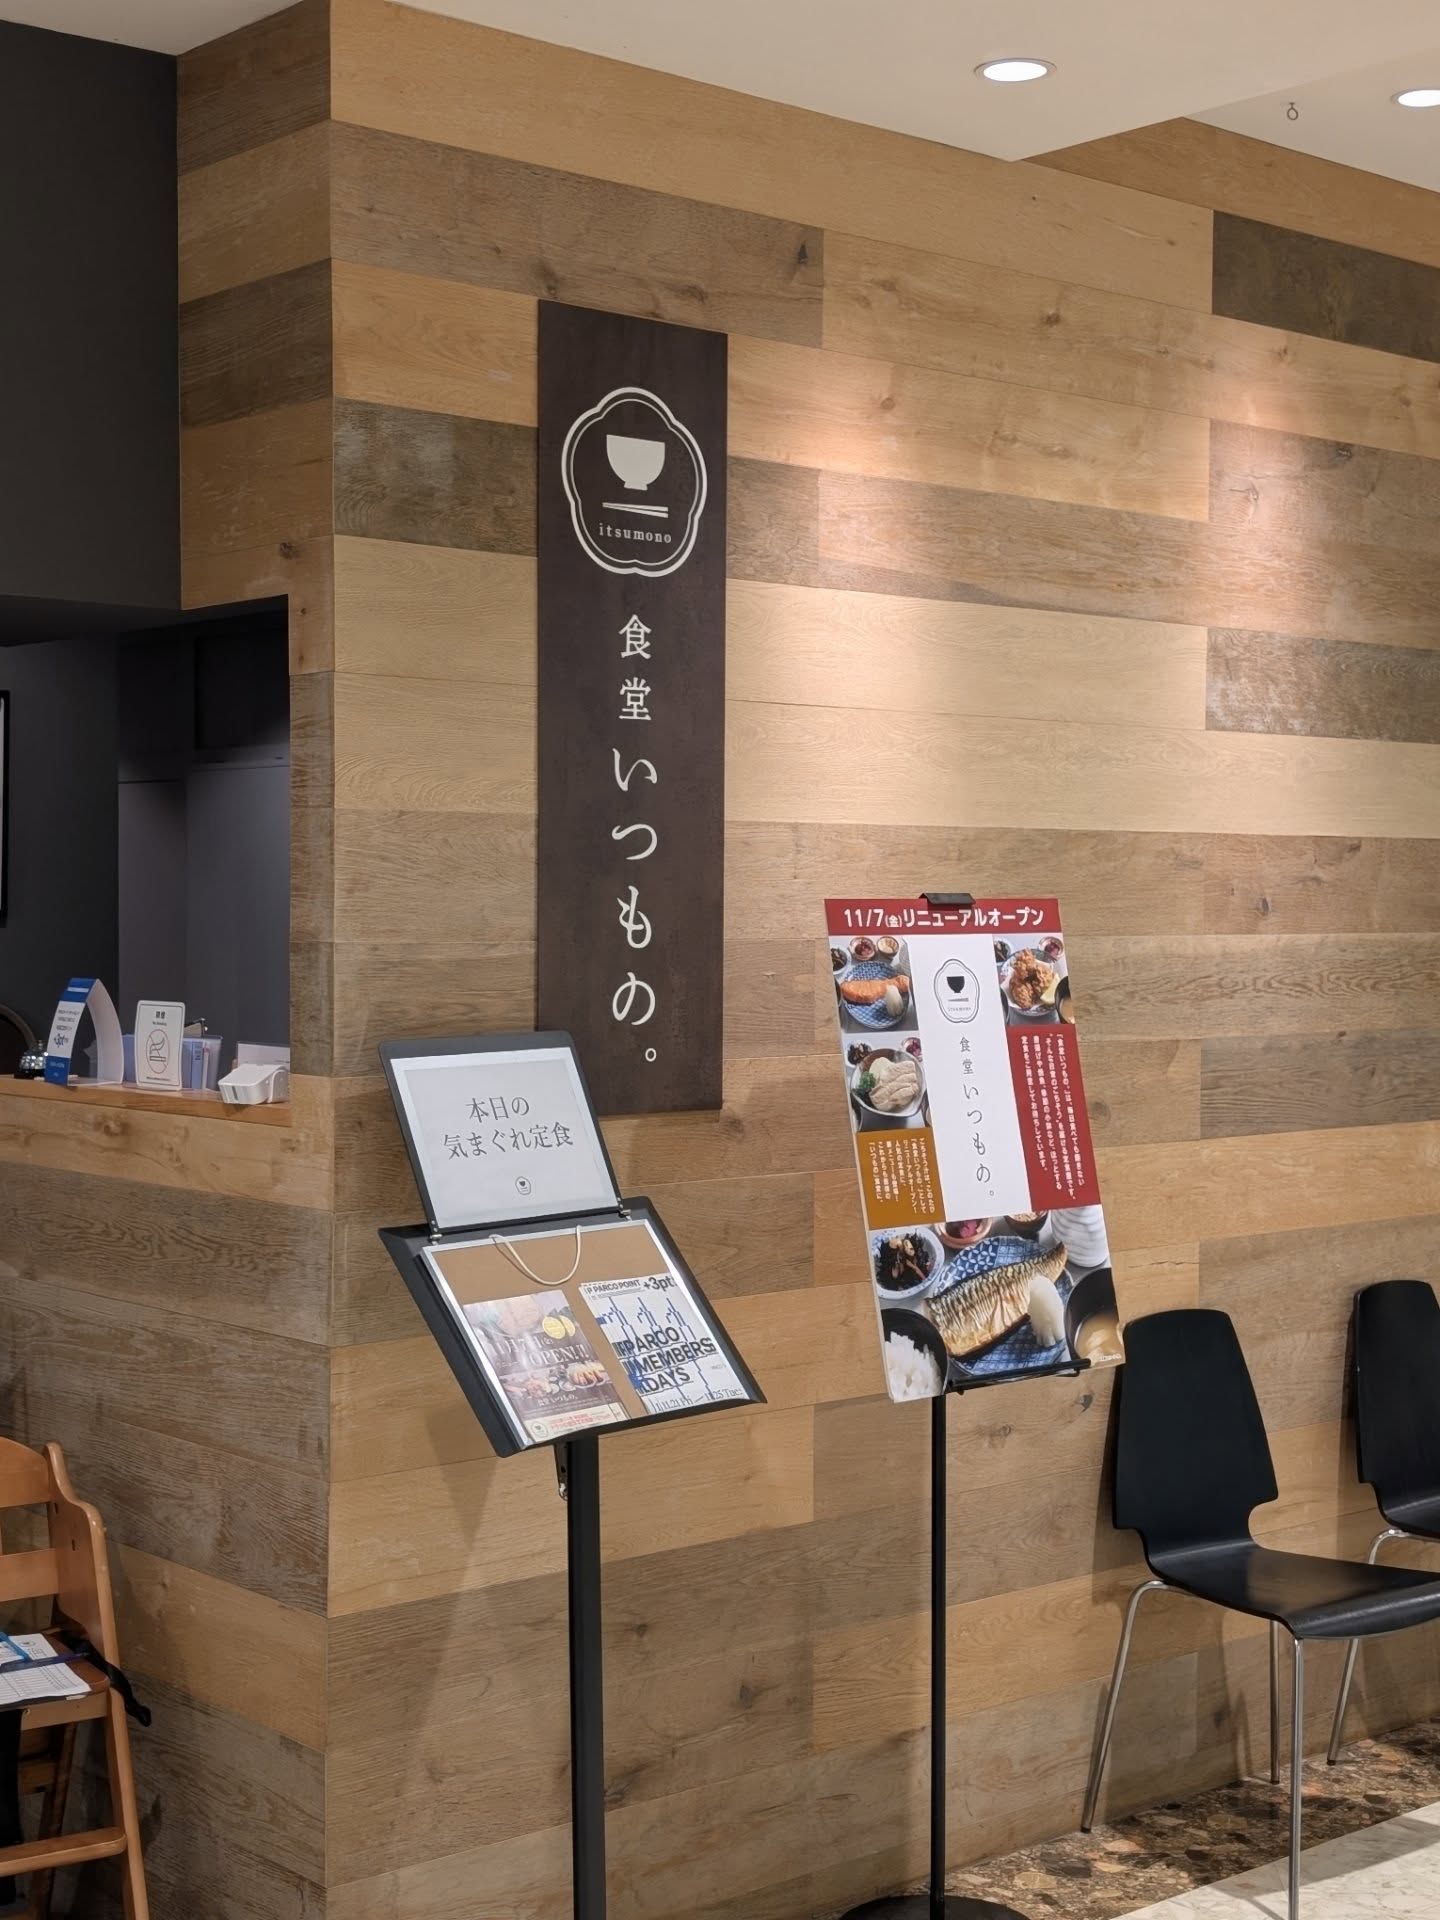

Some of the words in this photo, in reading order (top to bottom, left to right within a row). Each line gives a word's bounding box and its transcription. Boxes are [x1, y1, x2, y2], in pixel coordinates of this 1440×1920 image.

[599, 523, 672, 544] itsumono
[465, 1096, 530, 1123] 本日の
[443, 1121, 574, 1160] 気まぐれ定食
